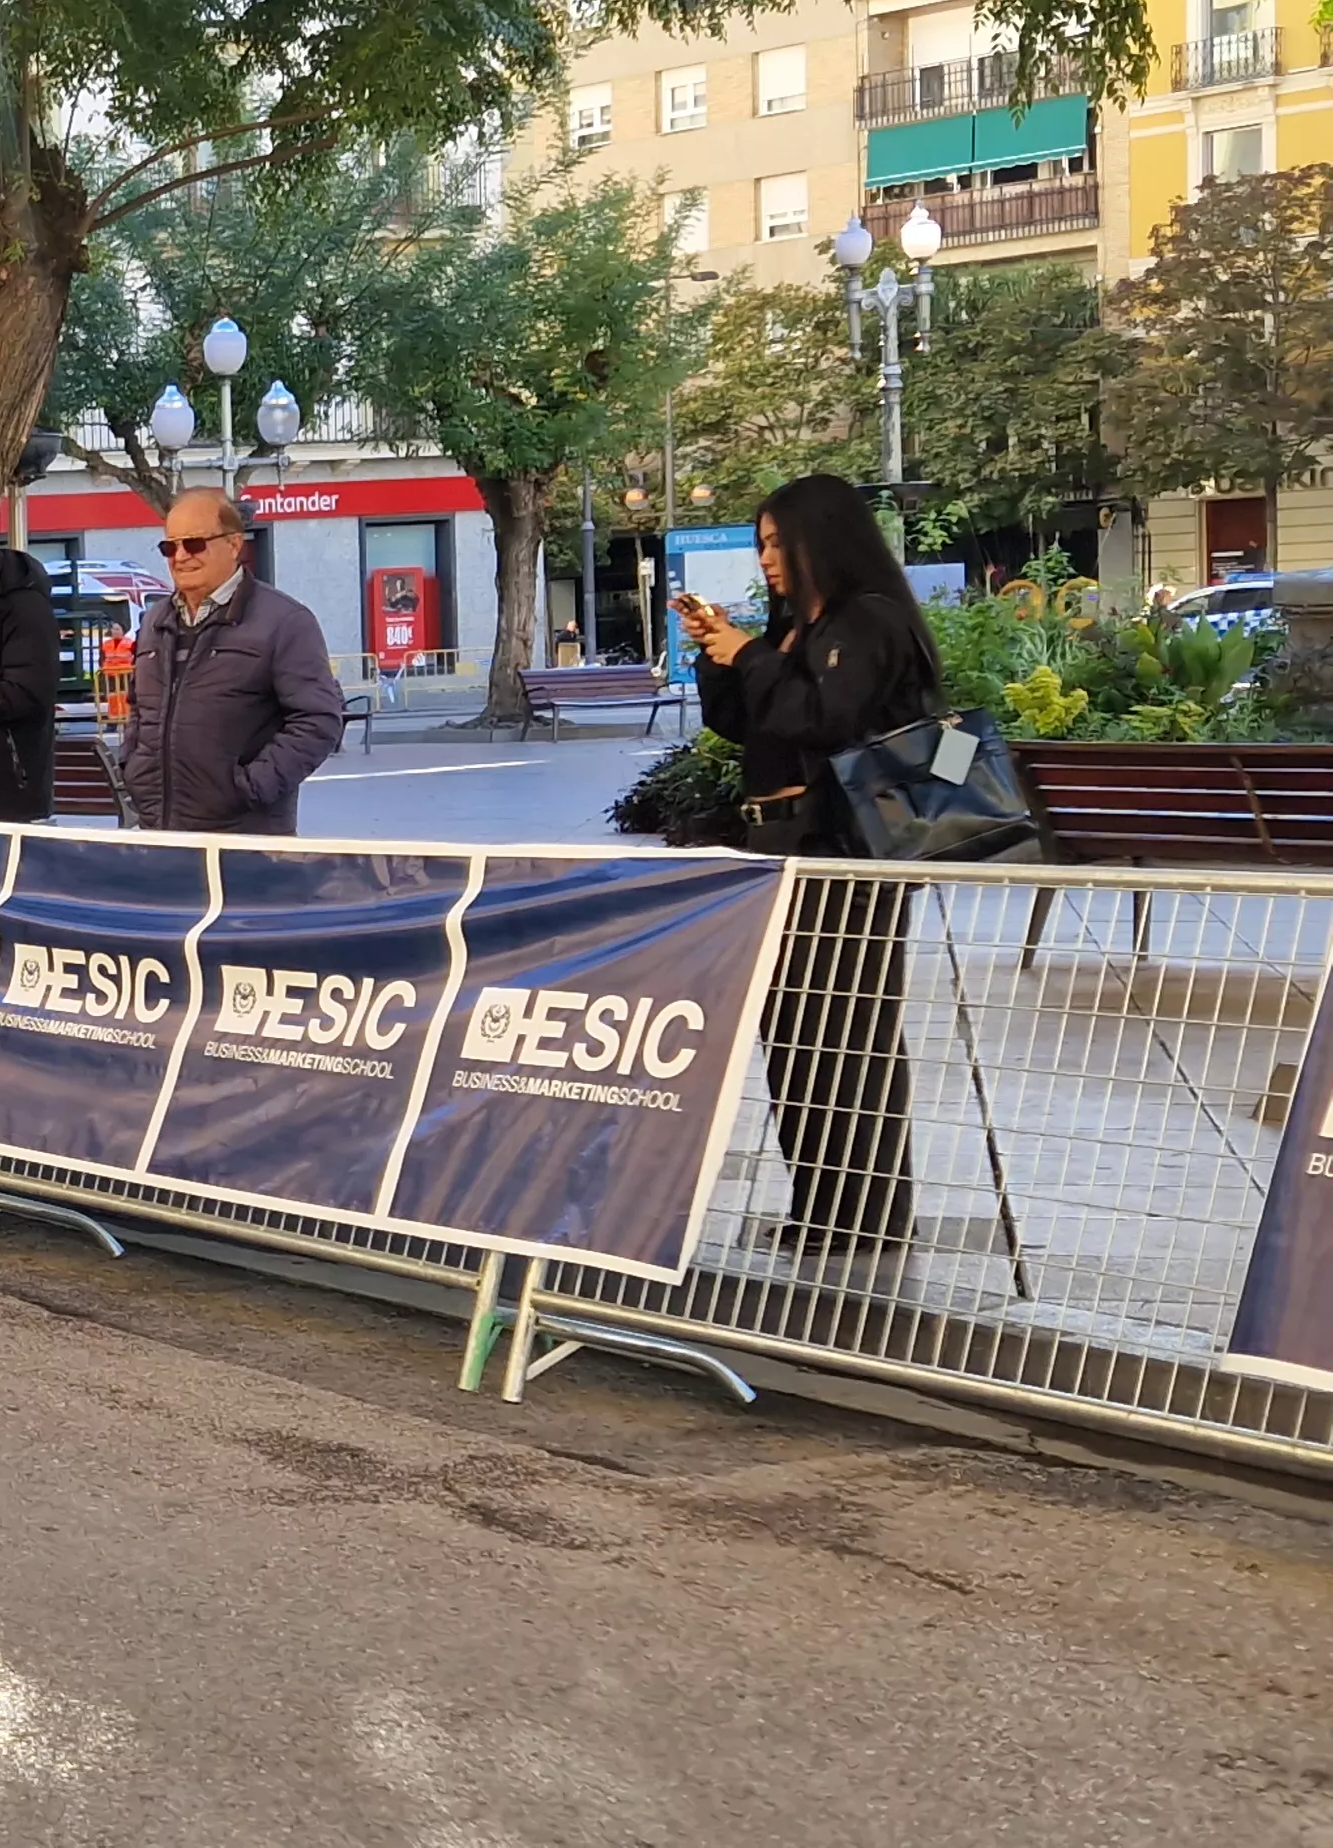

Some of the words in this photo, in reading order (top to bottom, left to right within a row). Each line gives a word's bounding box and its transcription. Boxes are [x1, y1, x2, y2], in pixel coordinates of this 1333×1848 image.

[44, 946, 171, 1024] ESIC
[259, 969, 418, 1051] ESIC
[516, 989, 706, 1080] ESIC
